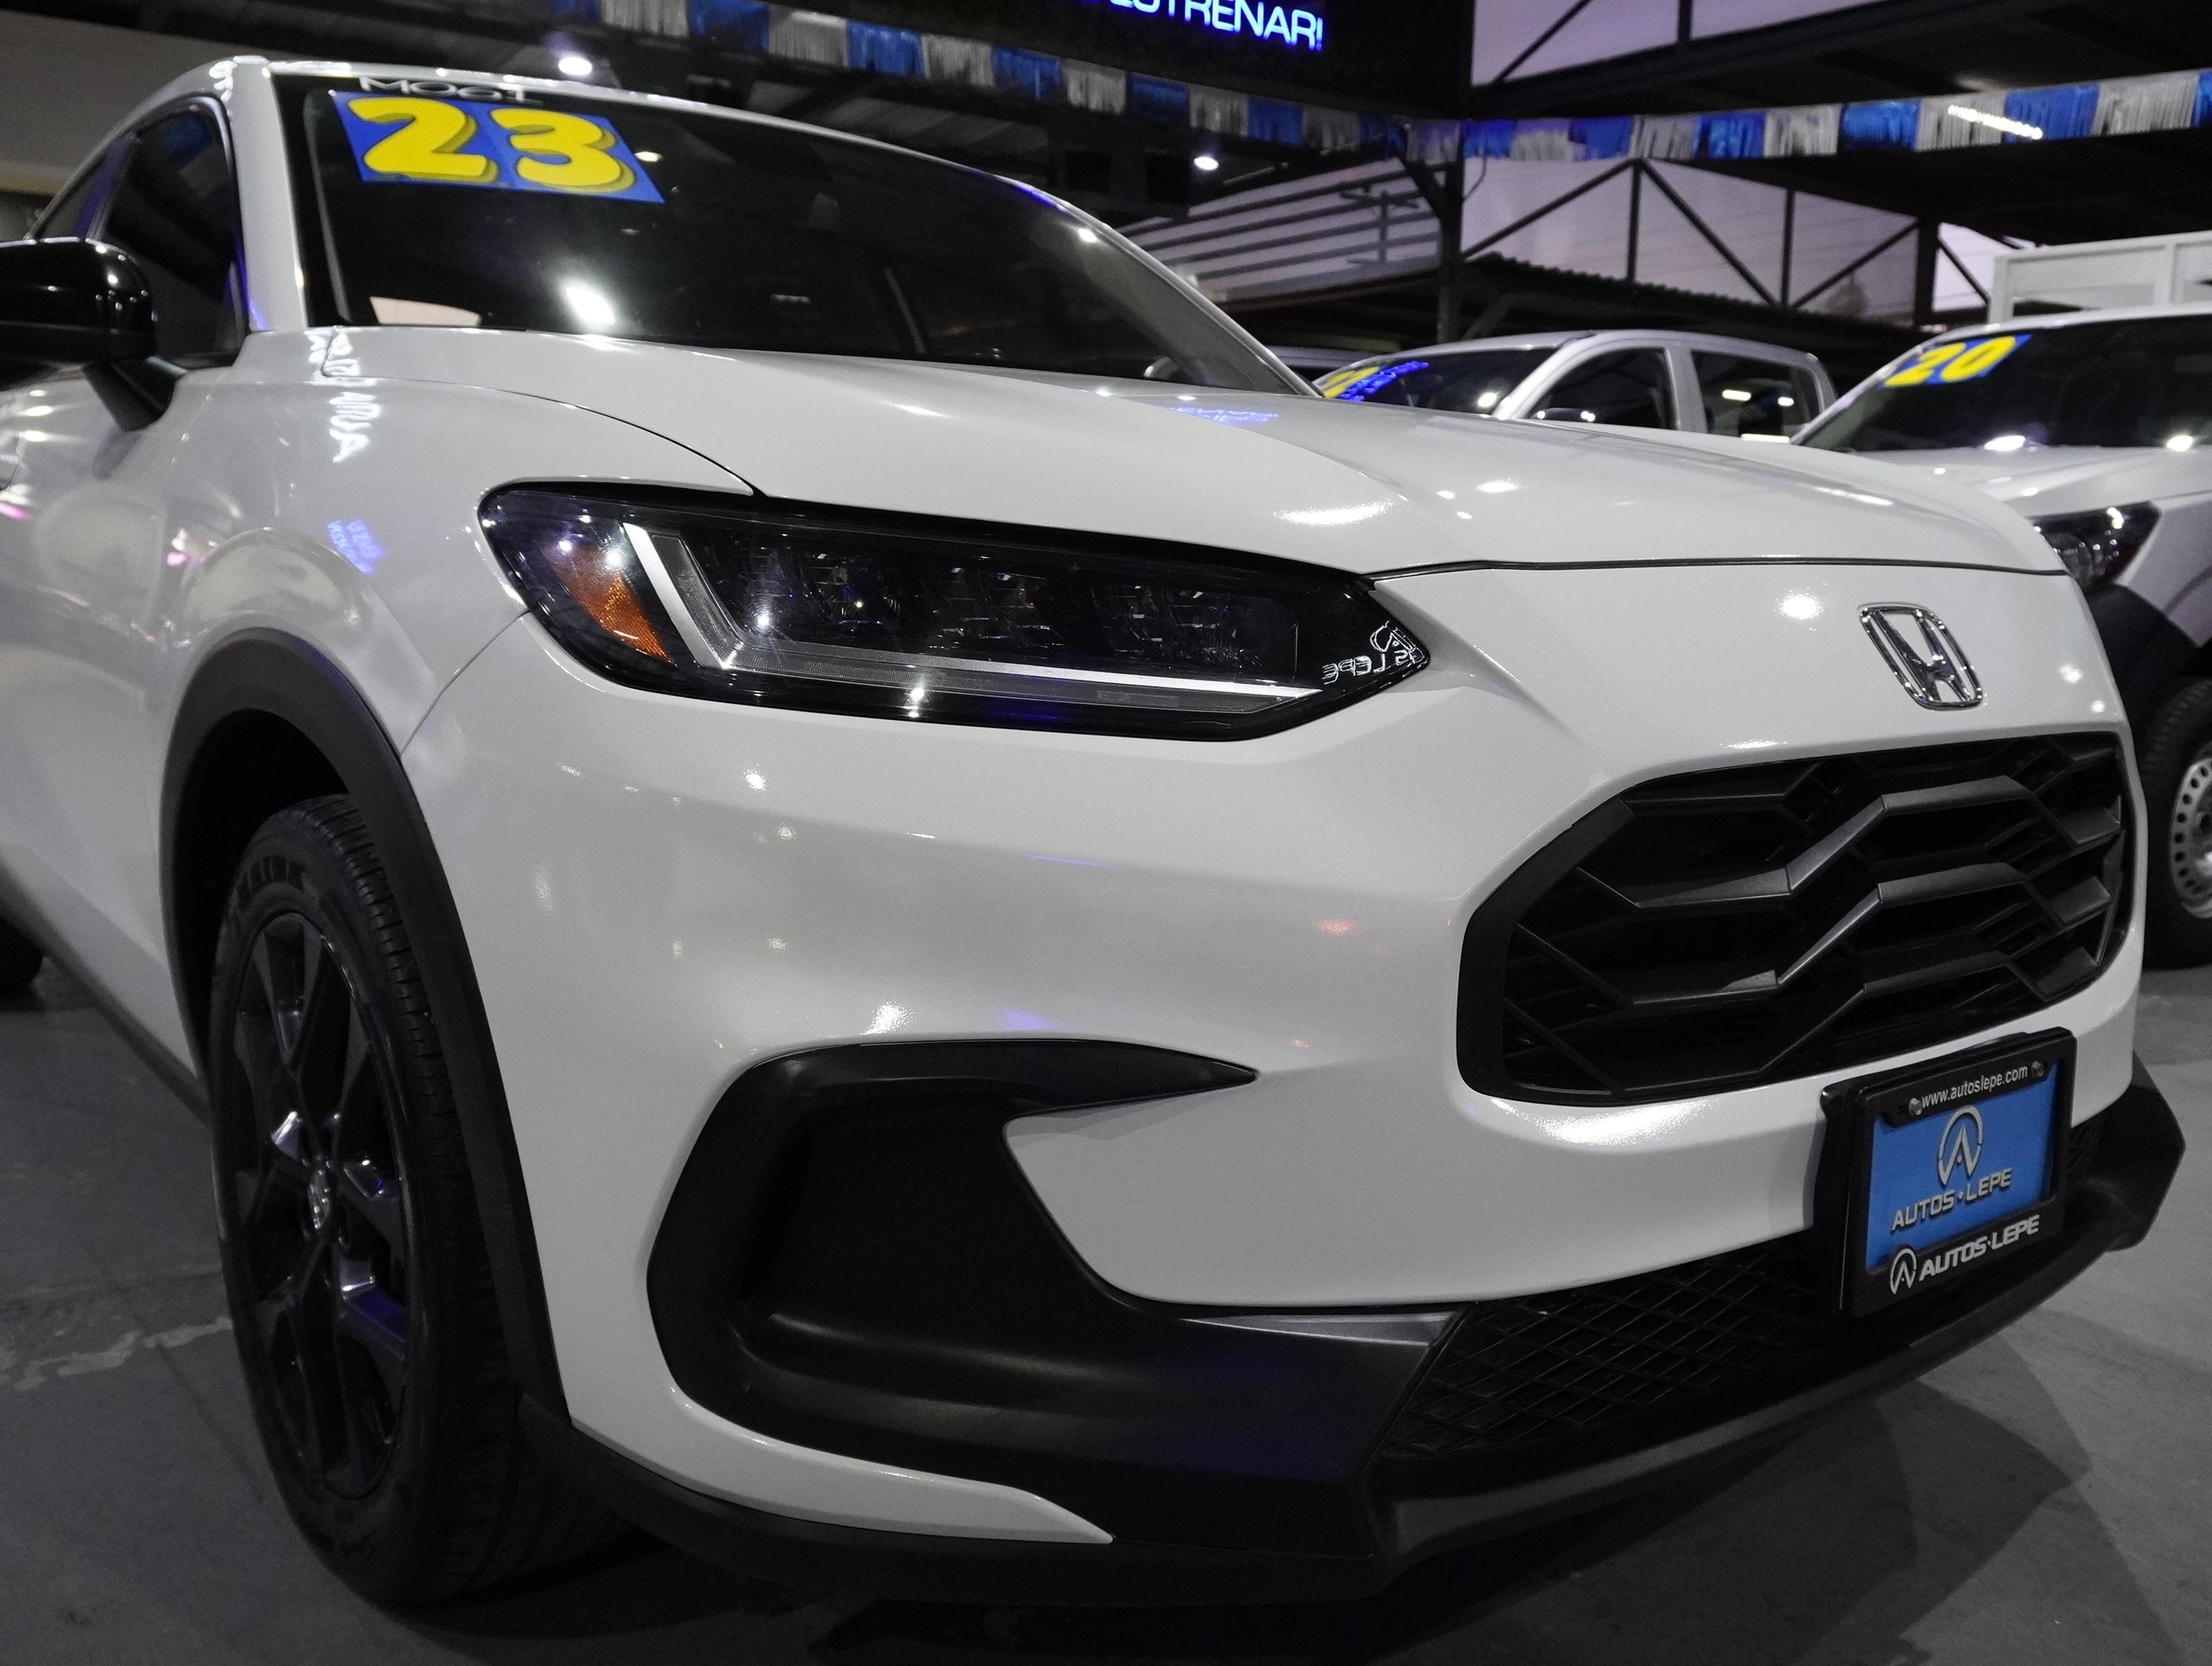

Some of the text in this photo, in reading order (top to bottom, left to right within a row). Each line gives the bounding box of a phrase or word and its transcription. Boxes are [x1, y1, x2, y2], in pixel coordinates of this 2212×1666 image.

[347, 96, 636, 193] 23
[1885, 335, 2016, 387] 20
[1921, 1066, 2029, 1109] www.autoslepe.com
